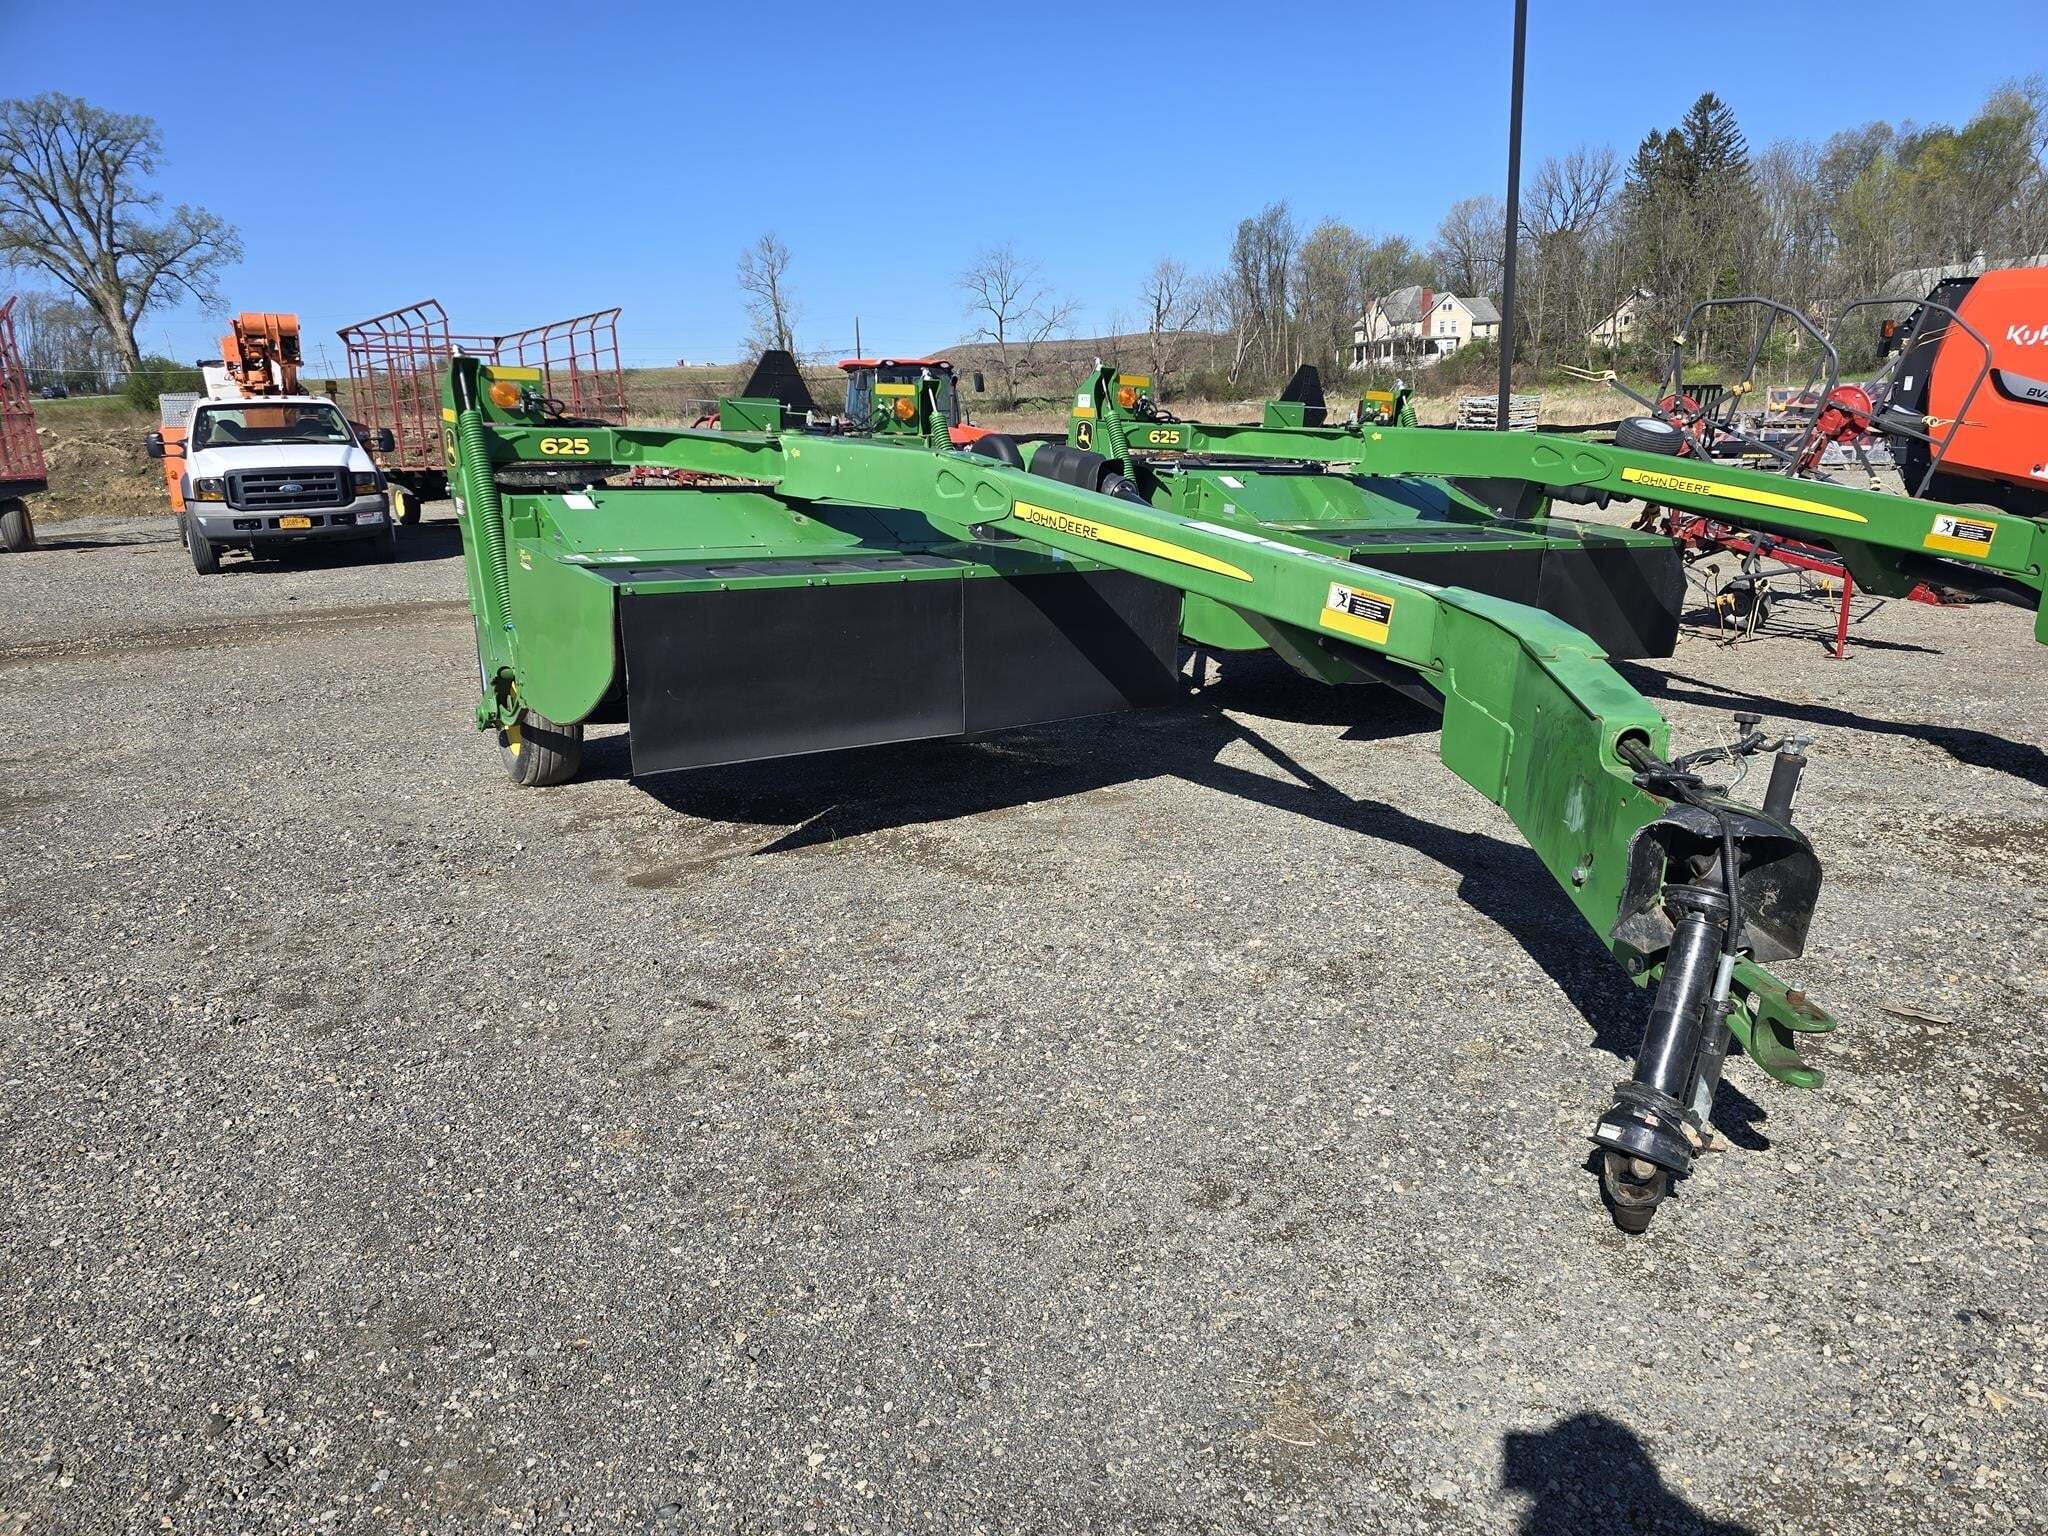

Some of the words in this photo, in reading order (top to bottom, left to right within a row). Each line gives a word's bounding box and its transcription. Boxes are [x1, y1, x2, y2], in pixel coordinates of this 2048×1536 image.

[540, 437, 590, 455] 625
[1149, 430, 1180, 444] 625
[1634, 472, 1667, 487] JOHN
[1669, 477, 1711, 494] DEERE
[1026, 508, 1057, 529] JOHN
[1059, 516, 1099, 538] DEERE
